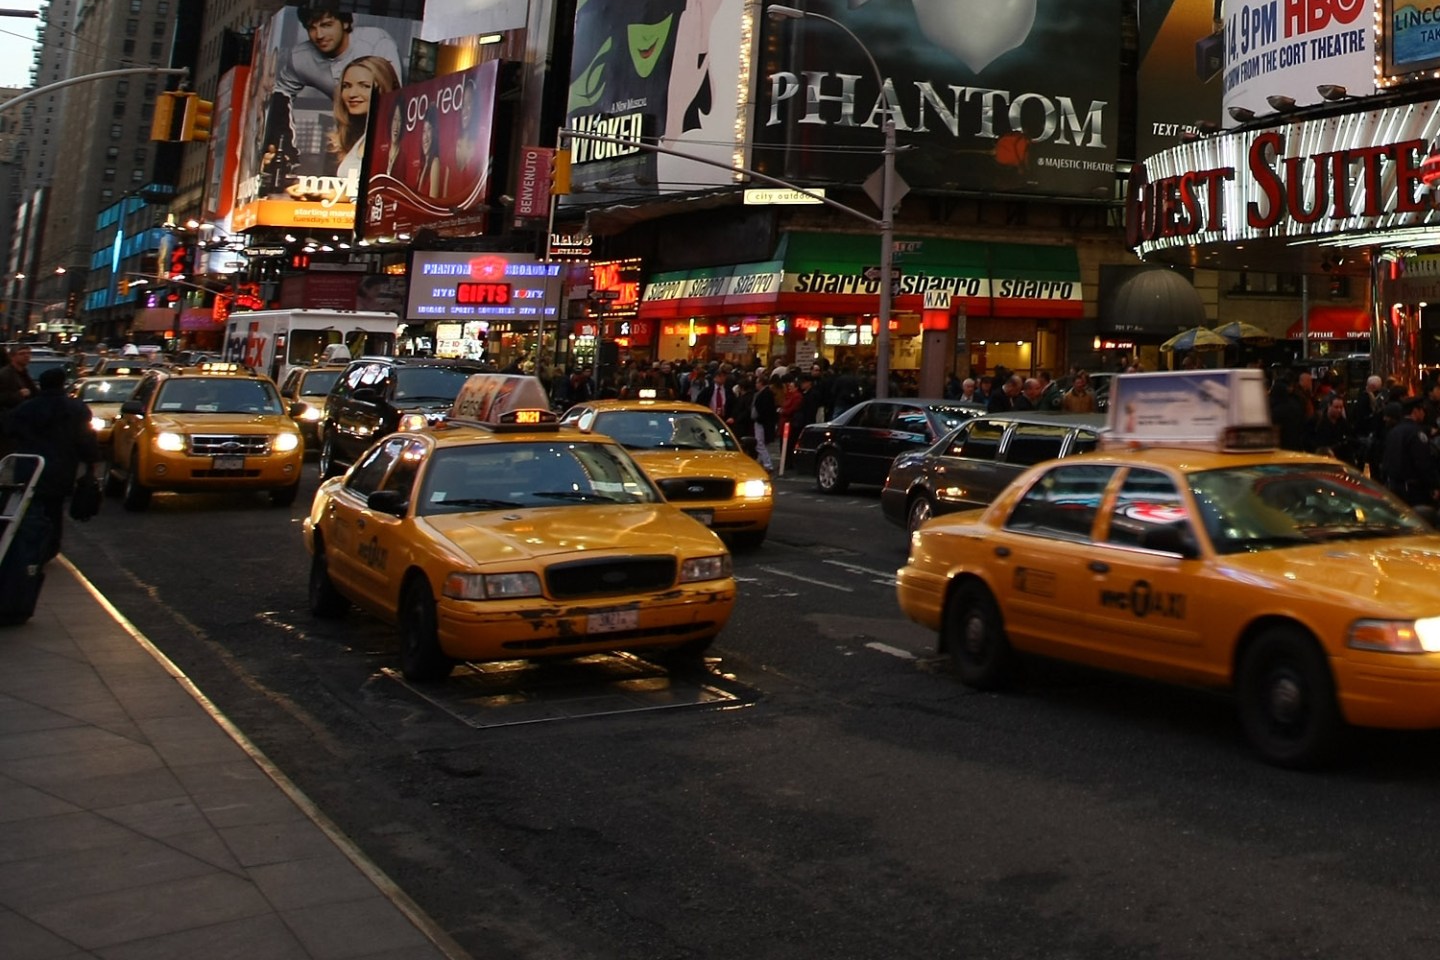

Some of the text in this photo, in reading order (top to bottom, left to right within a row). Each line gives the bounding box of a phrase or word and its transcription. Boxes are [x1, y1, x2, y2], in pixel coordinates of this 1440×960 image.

[1240, 28, 1366, 83] FROM THE CORT THEATRE
[436, 73, 466, 114] red
[766, 71, 1108, 148] PHANTOM
[1152, 122, 1179, 136] TEXT
[1045, 156, 1115, 173] MAJESTIC THEATRE
[520, 151, 538, 214] BENVENUTO
[755, 192, 773, 202] city
[1127, 162, 1235, 252] GUEST
[456, 284, 509, 304] GIFTS
[688, 277, 725, 298] sbarro
[734, 272, 774, 295] sbarro
[1000, 277, 1073, 300] sbarro
[516, 411, 540, 424] 3N21
